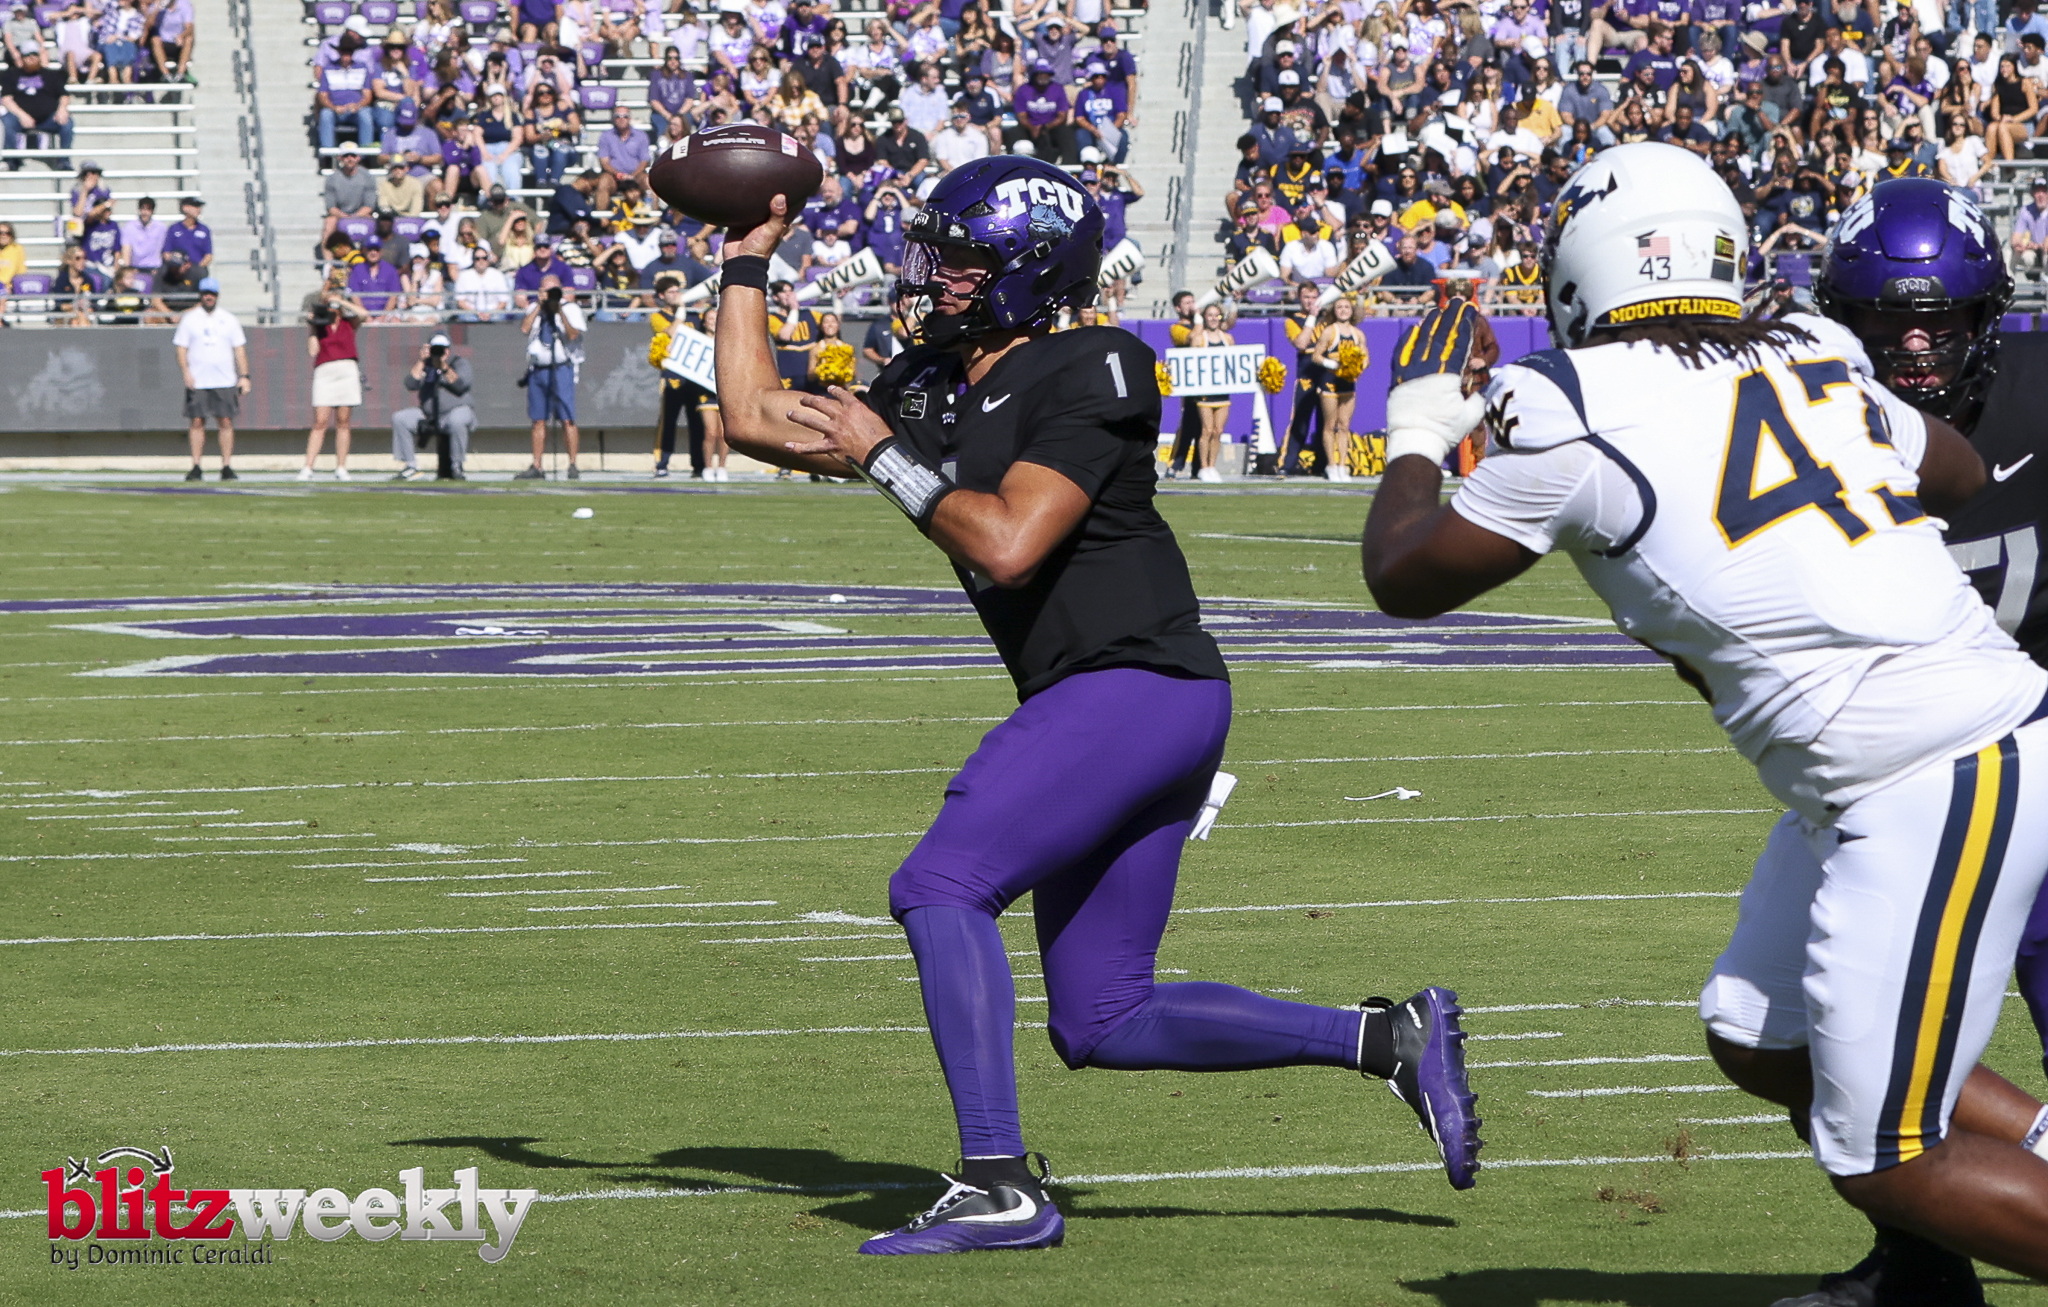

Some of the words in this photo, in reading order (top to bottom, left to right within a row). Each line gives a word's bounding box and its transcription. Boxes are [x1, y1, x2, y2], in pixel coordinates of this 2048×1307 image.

[994, 178, 1085, 223] TCU
[815, 258, 867, 294] WVU
[1214, 258, 1259, 298] WVU
[1333, 250, 1380, 293] WVU
[1638, 256, 1671, 281] 43
[1894, 278, 1931, 295] TCU
[1104, 352, 1128, 398] 1
[1168, 352, 1266, 387] DEFENSE
[1711, 357, 1928, 551] 43
